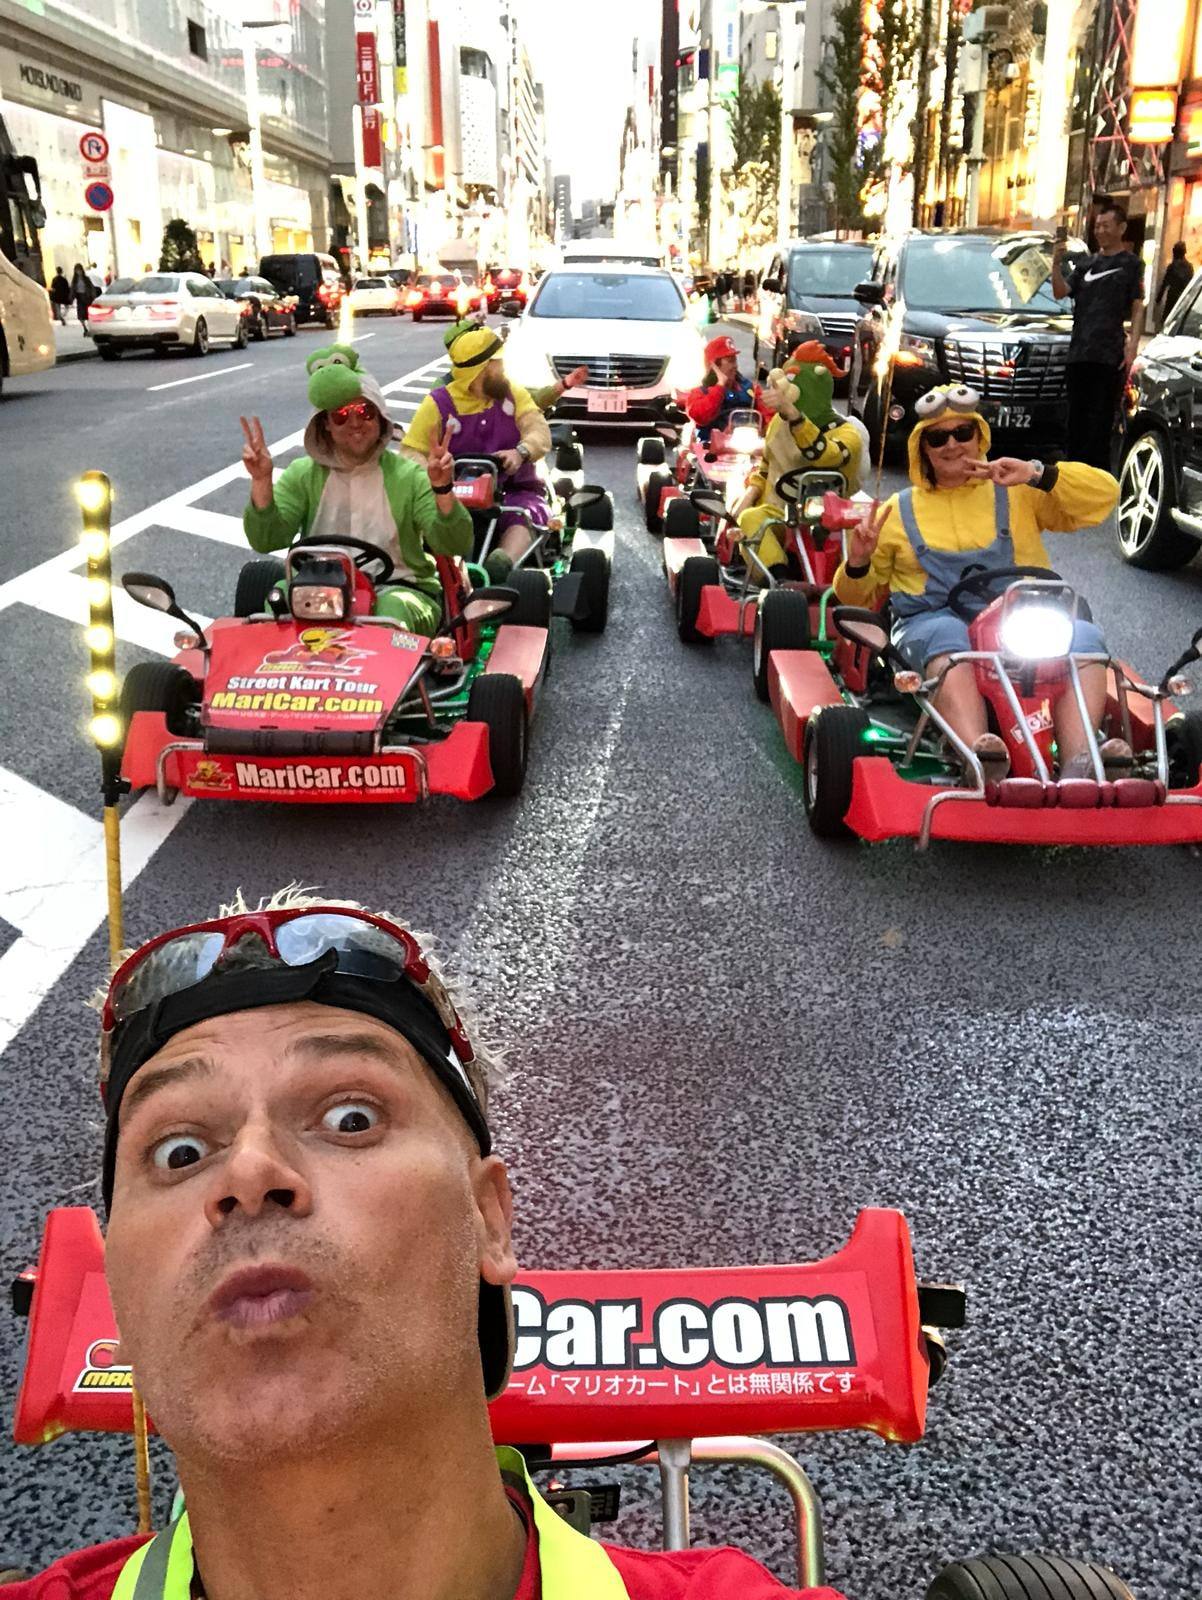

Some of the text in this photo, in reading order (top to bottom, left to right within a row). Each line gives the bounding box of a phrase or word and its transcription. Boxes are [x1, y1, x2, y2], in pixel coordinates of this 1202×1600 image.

[227, 676, 378, 695] Street Kart Tour
[211, 692, 383, 714] MariCar.com
[235, 762, 406, 788] MariCar.com
